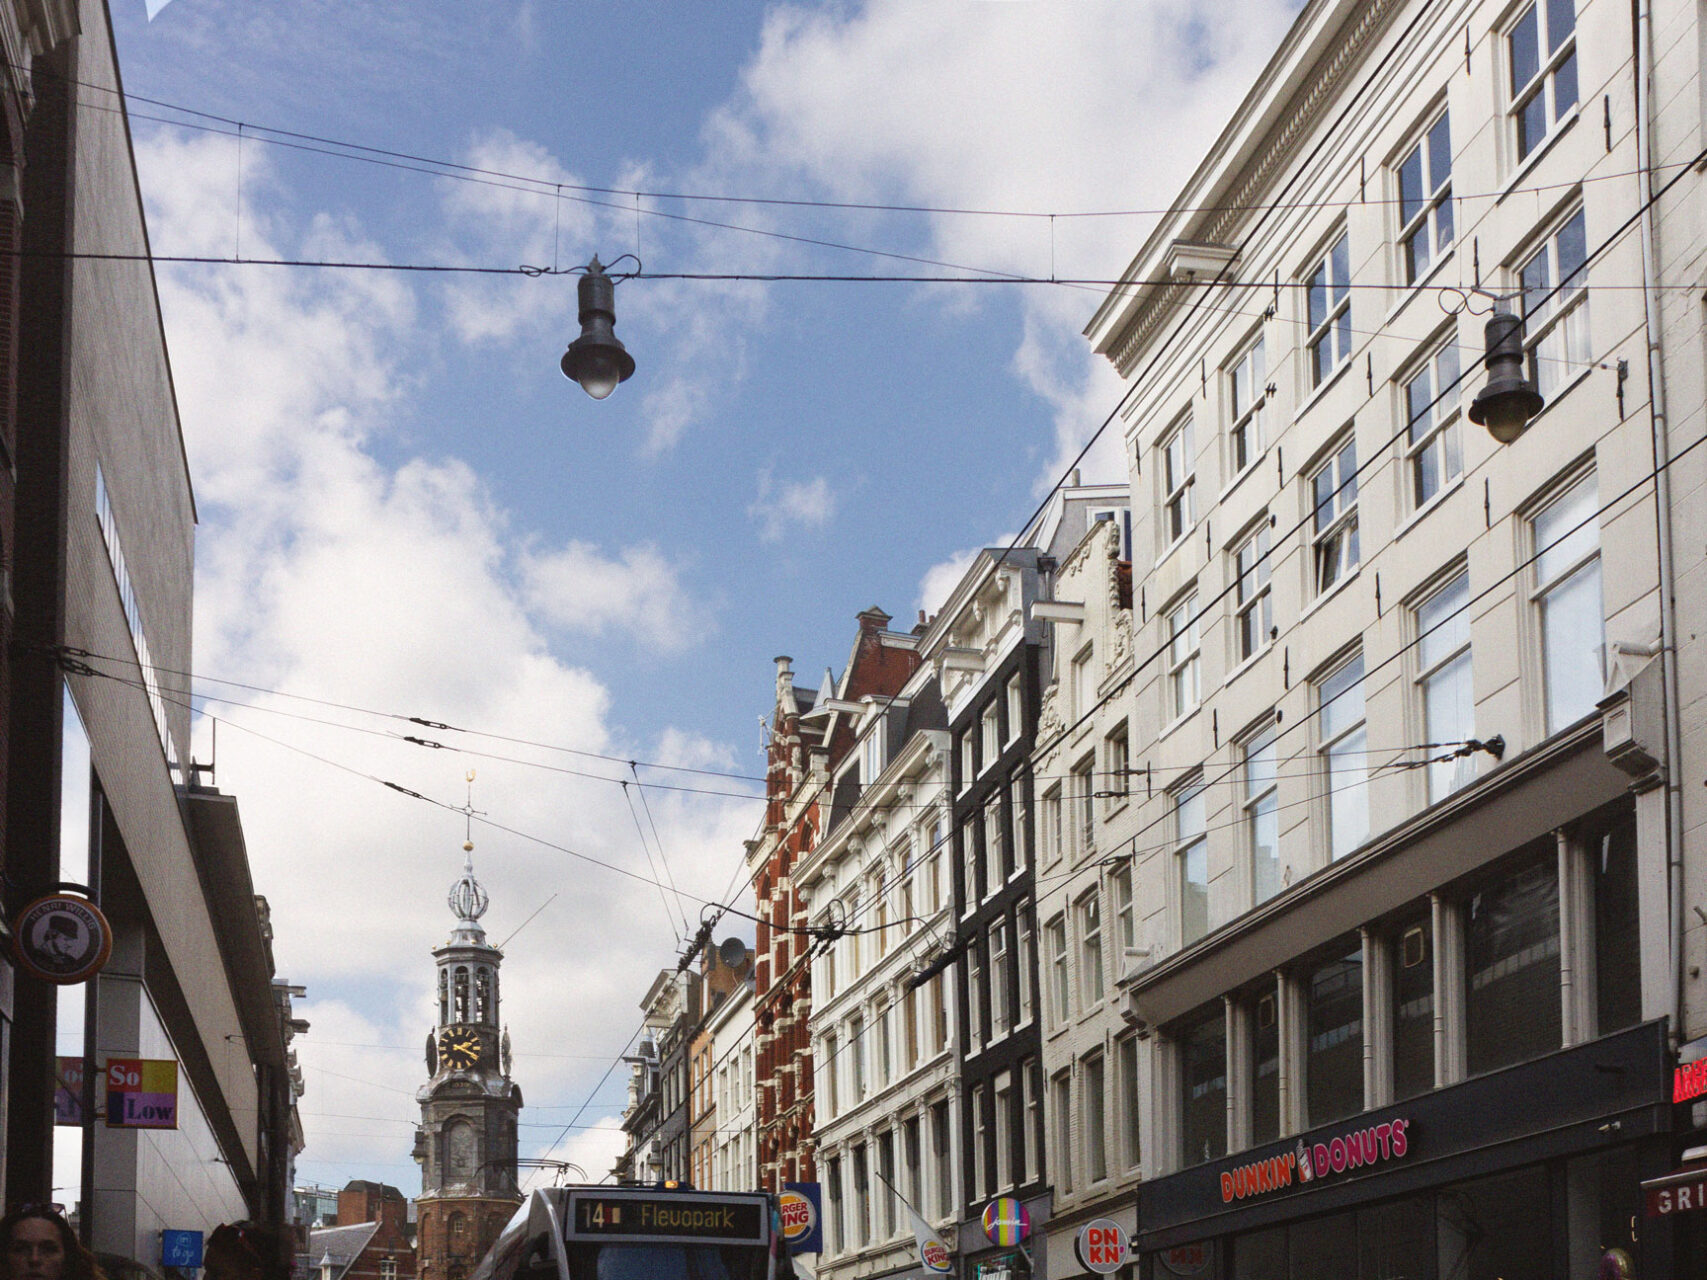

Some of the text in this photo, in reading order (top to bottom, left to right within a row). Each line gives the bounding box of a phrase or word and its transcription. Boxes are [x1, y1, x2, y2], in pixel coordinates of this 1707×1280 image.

[109, 1064, 140, 1086] So
[126, 1098, 173, 1121] Low
[1220, 1119, 1408, 1203] DUNKIN' DONUTS
[584, 1202, 605, 1228] 14
[782, 1202, 807, 1214] RGER
[783, 1210, 808, 1226] ING
[1088, 1228, 1118, 1245] DN
